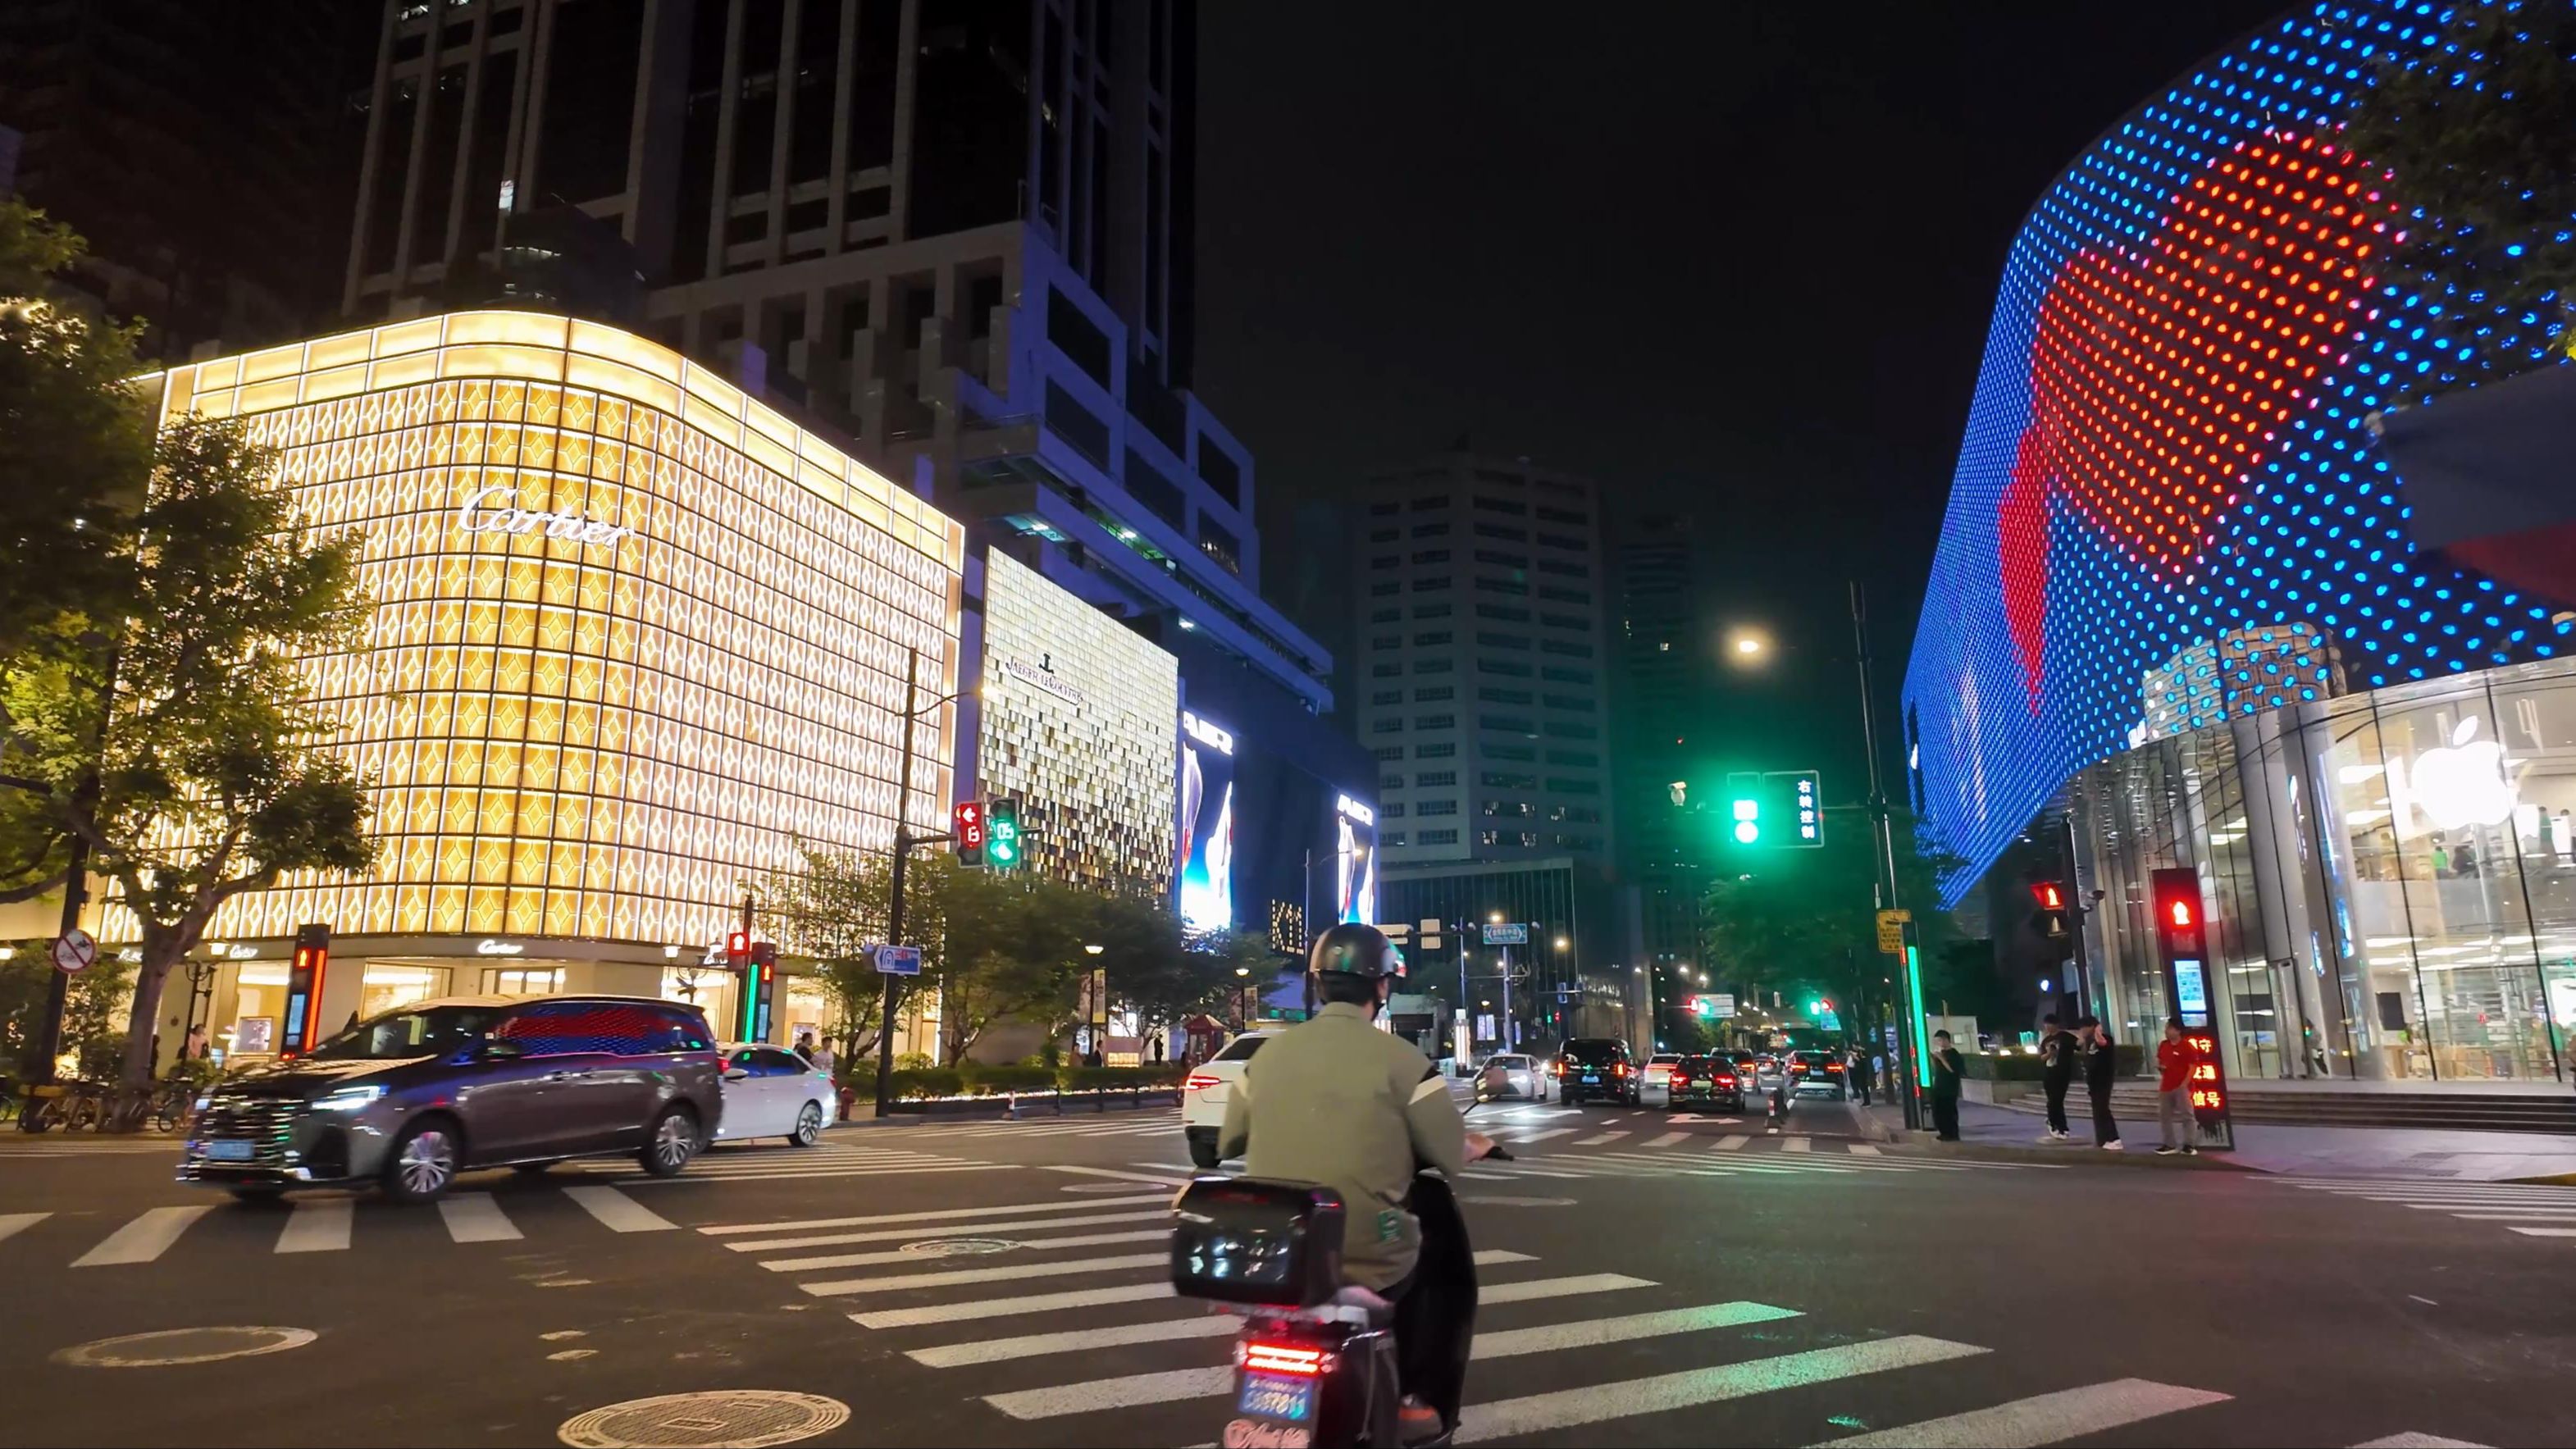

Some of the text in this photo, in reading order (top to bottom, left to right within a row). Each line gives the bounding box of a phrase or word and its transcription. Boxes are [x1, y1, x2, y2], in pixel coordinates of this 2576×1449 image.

[458, 486, 636, 549] Cartier
[477, 941, 523, 955] Cartier
[2188, 1038, 2212, 1053] 守
[2193, 1091, 2221, 1107] 信号
